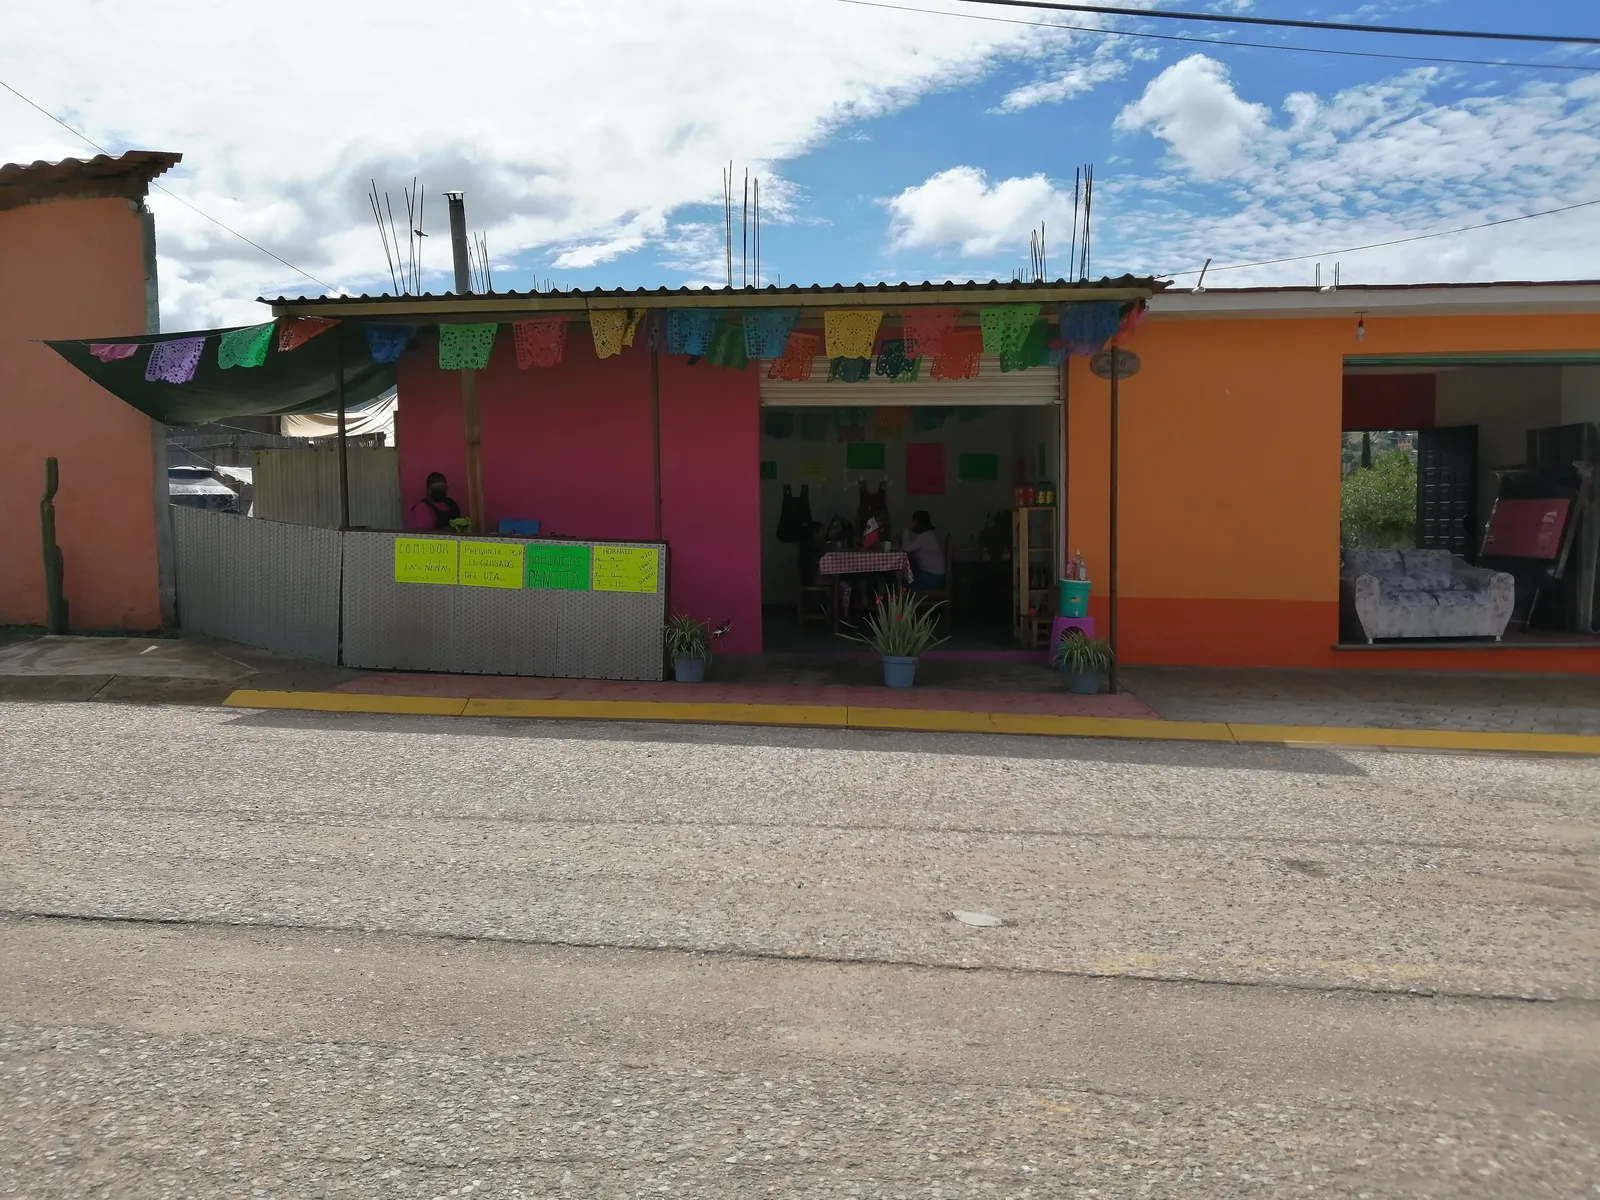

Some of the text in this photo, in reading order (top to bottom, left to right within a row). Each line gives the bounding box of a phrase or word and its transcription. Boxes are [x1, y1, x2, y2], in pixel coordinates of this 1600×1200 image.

[399, 543, 449, 555] COMEDOR
[468, 558, 515, 569] EL GUISADO
[464, 571, 479, 580] DEL
[528, 569, 583, 591] PANCITA
